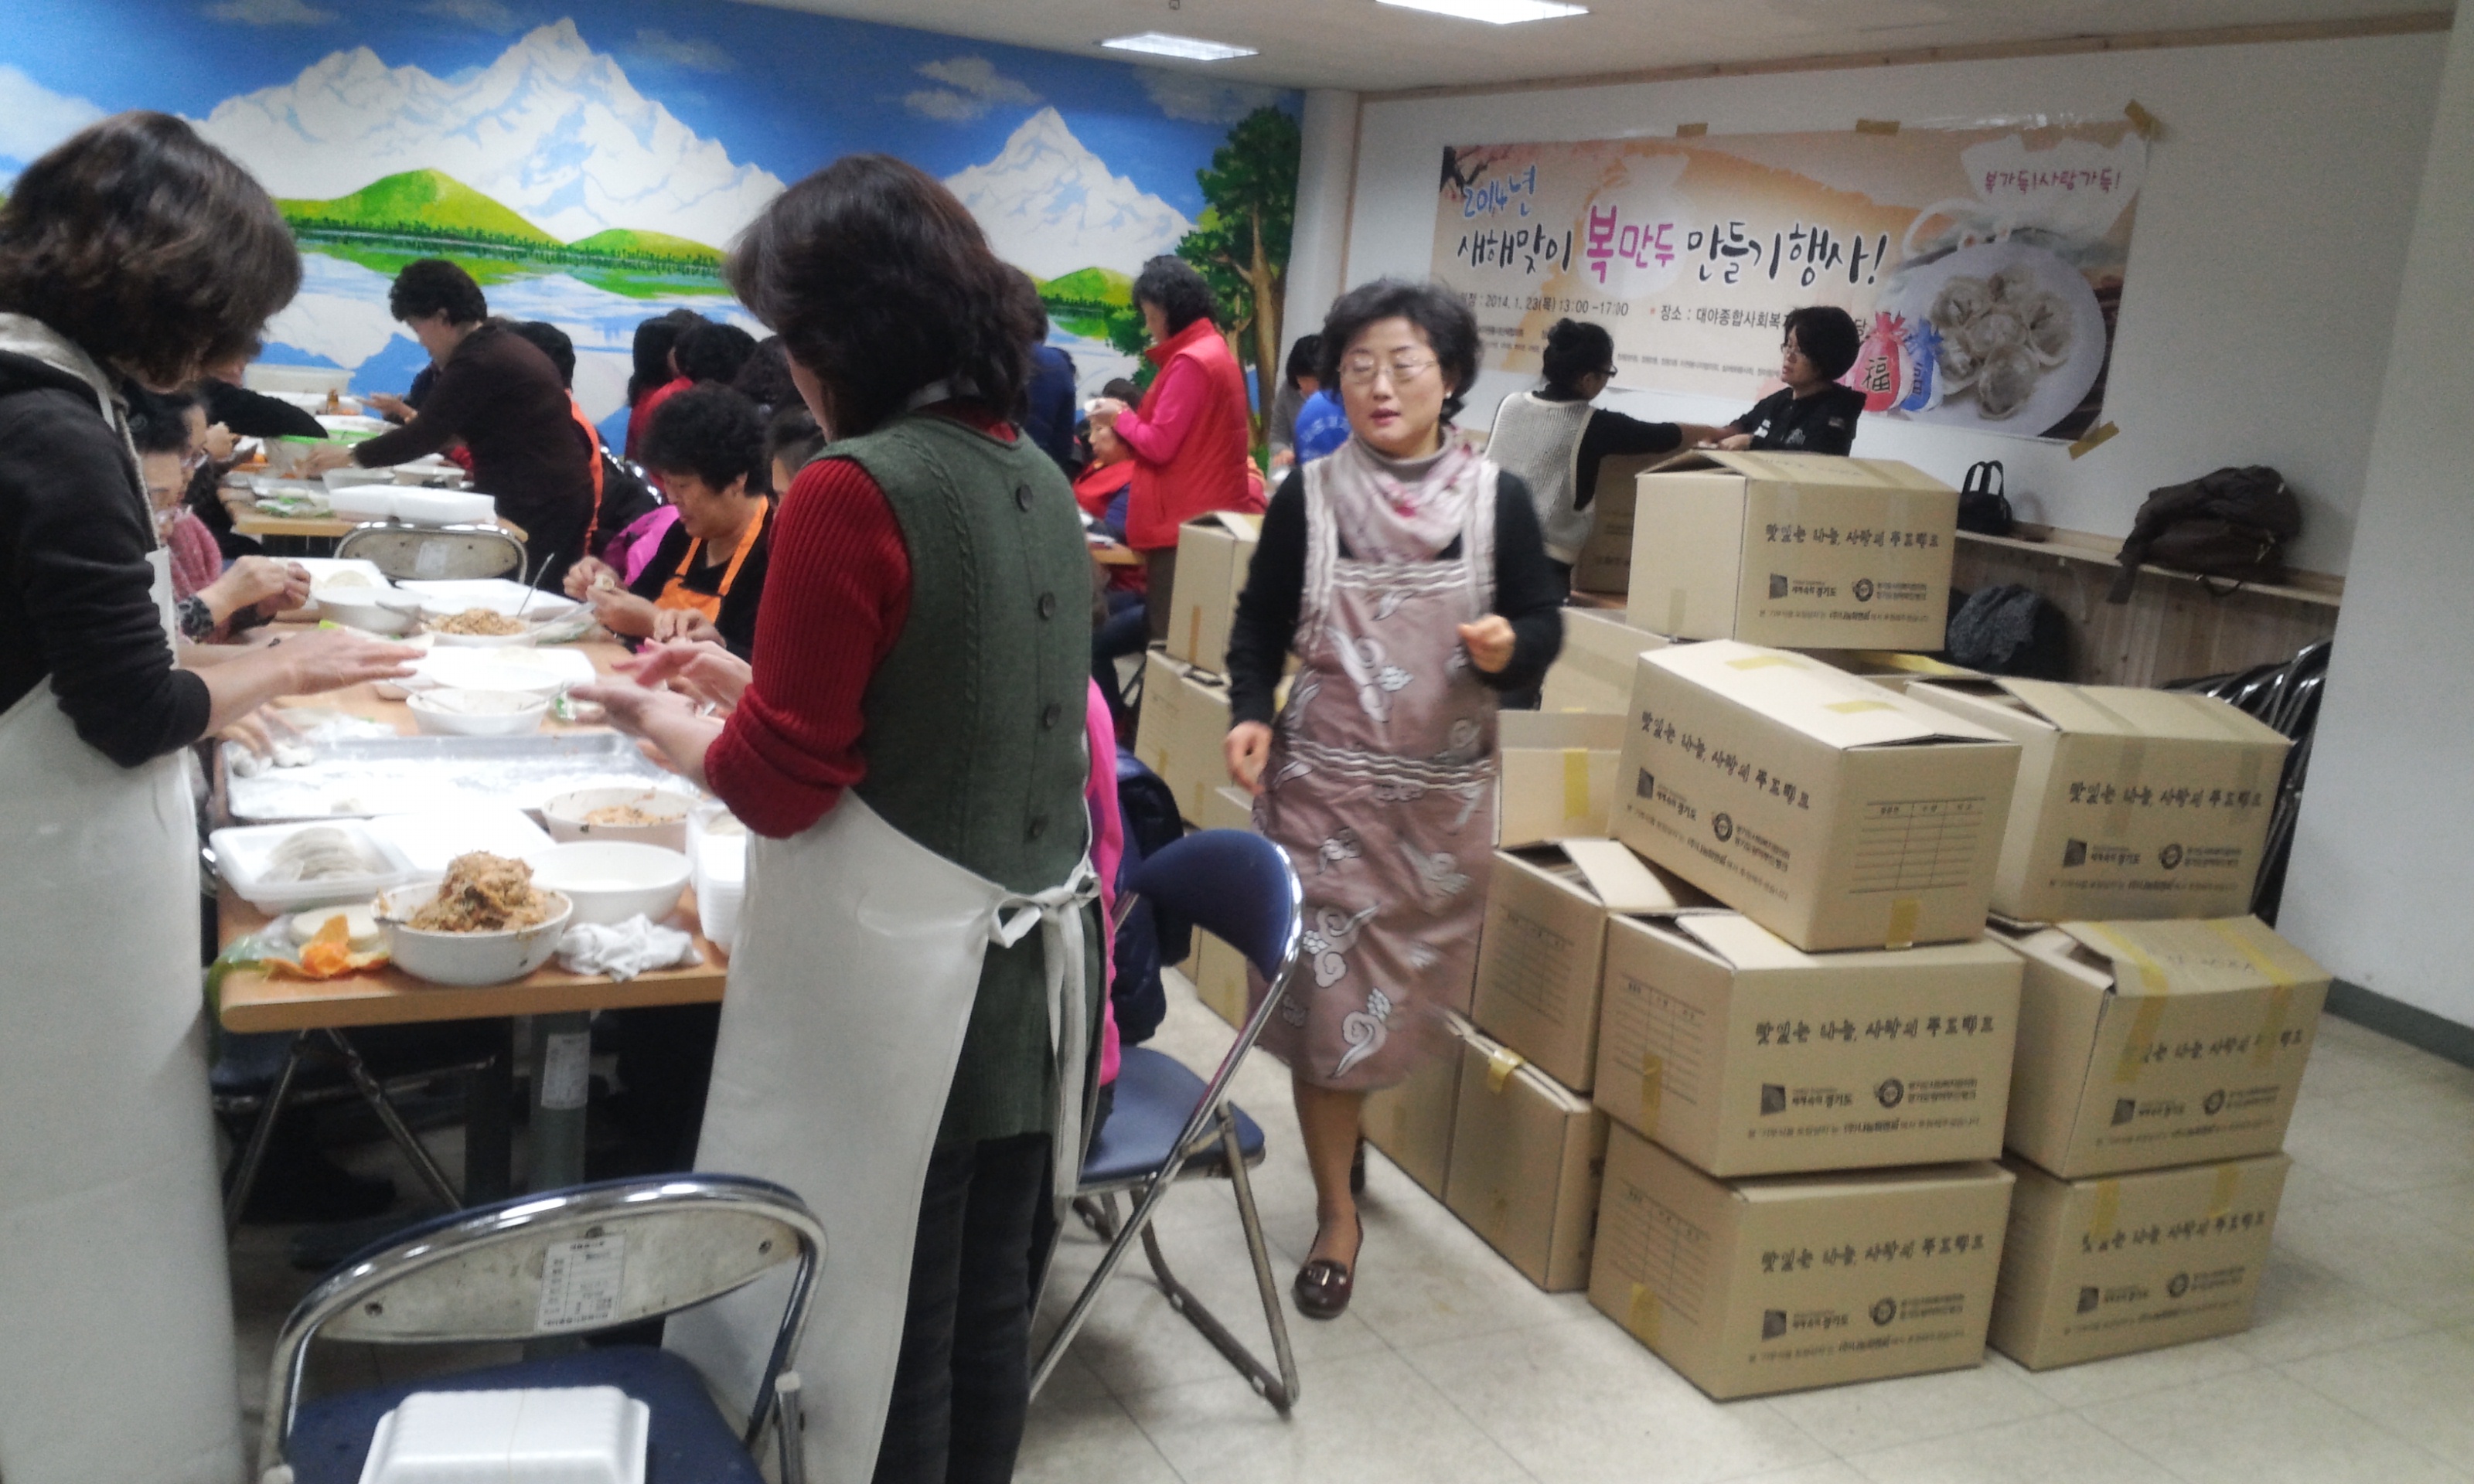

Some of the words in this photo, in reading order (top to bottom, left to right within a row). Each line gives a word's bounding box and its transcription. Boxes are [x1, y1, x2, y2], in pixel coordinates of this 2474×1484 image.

[1464, 165, 1536, 217] 2014년
[1458, 223, 1572, 274] 새해맞이
[1587, 206, 1675, 284] 복만두
[1661, 305, 1682, 322] 장소
[1696, 307, 1788, 330] 대야종합사회복
[1862, 356, 1891, 392] 福
[1641, 710, 1676, 744] 맛있는
[1711, 750, 1750, 783] 사랑의
[1757, 1019, 1810, 1044] 맛있는
[1866, 1016, 1919, 1040] 사랑의
